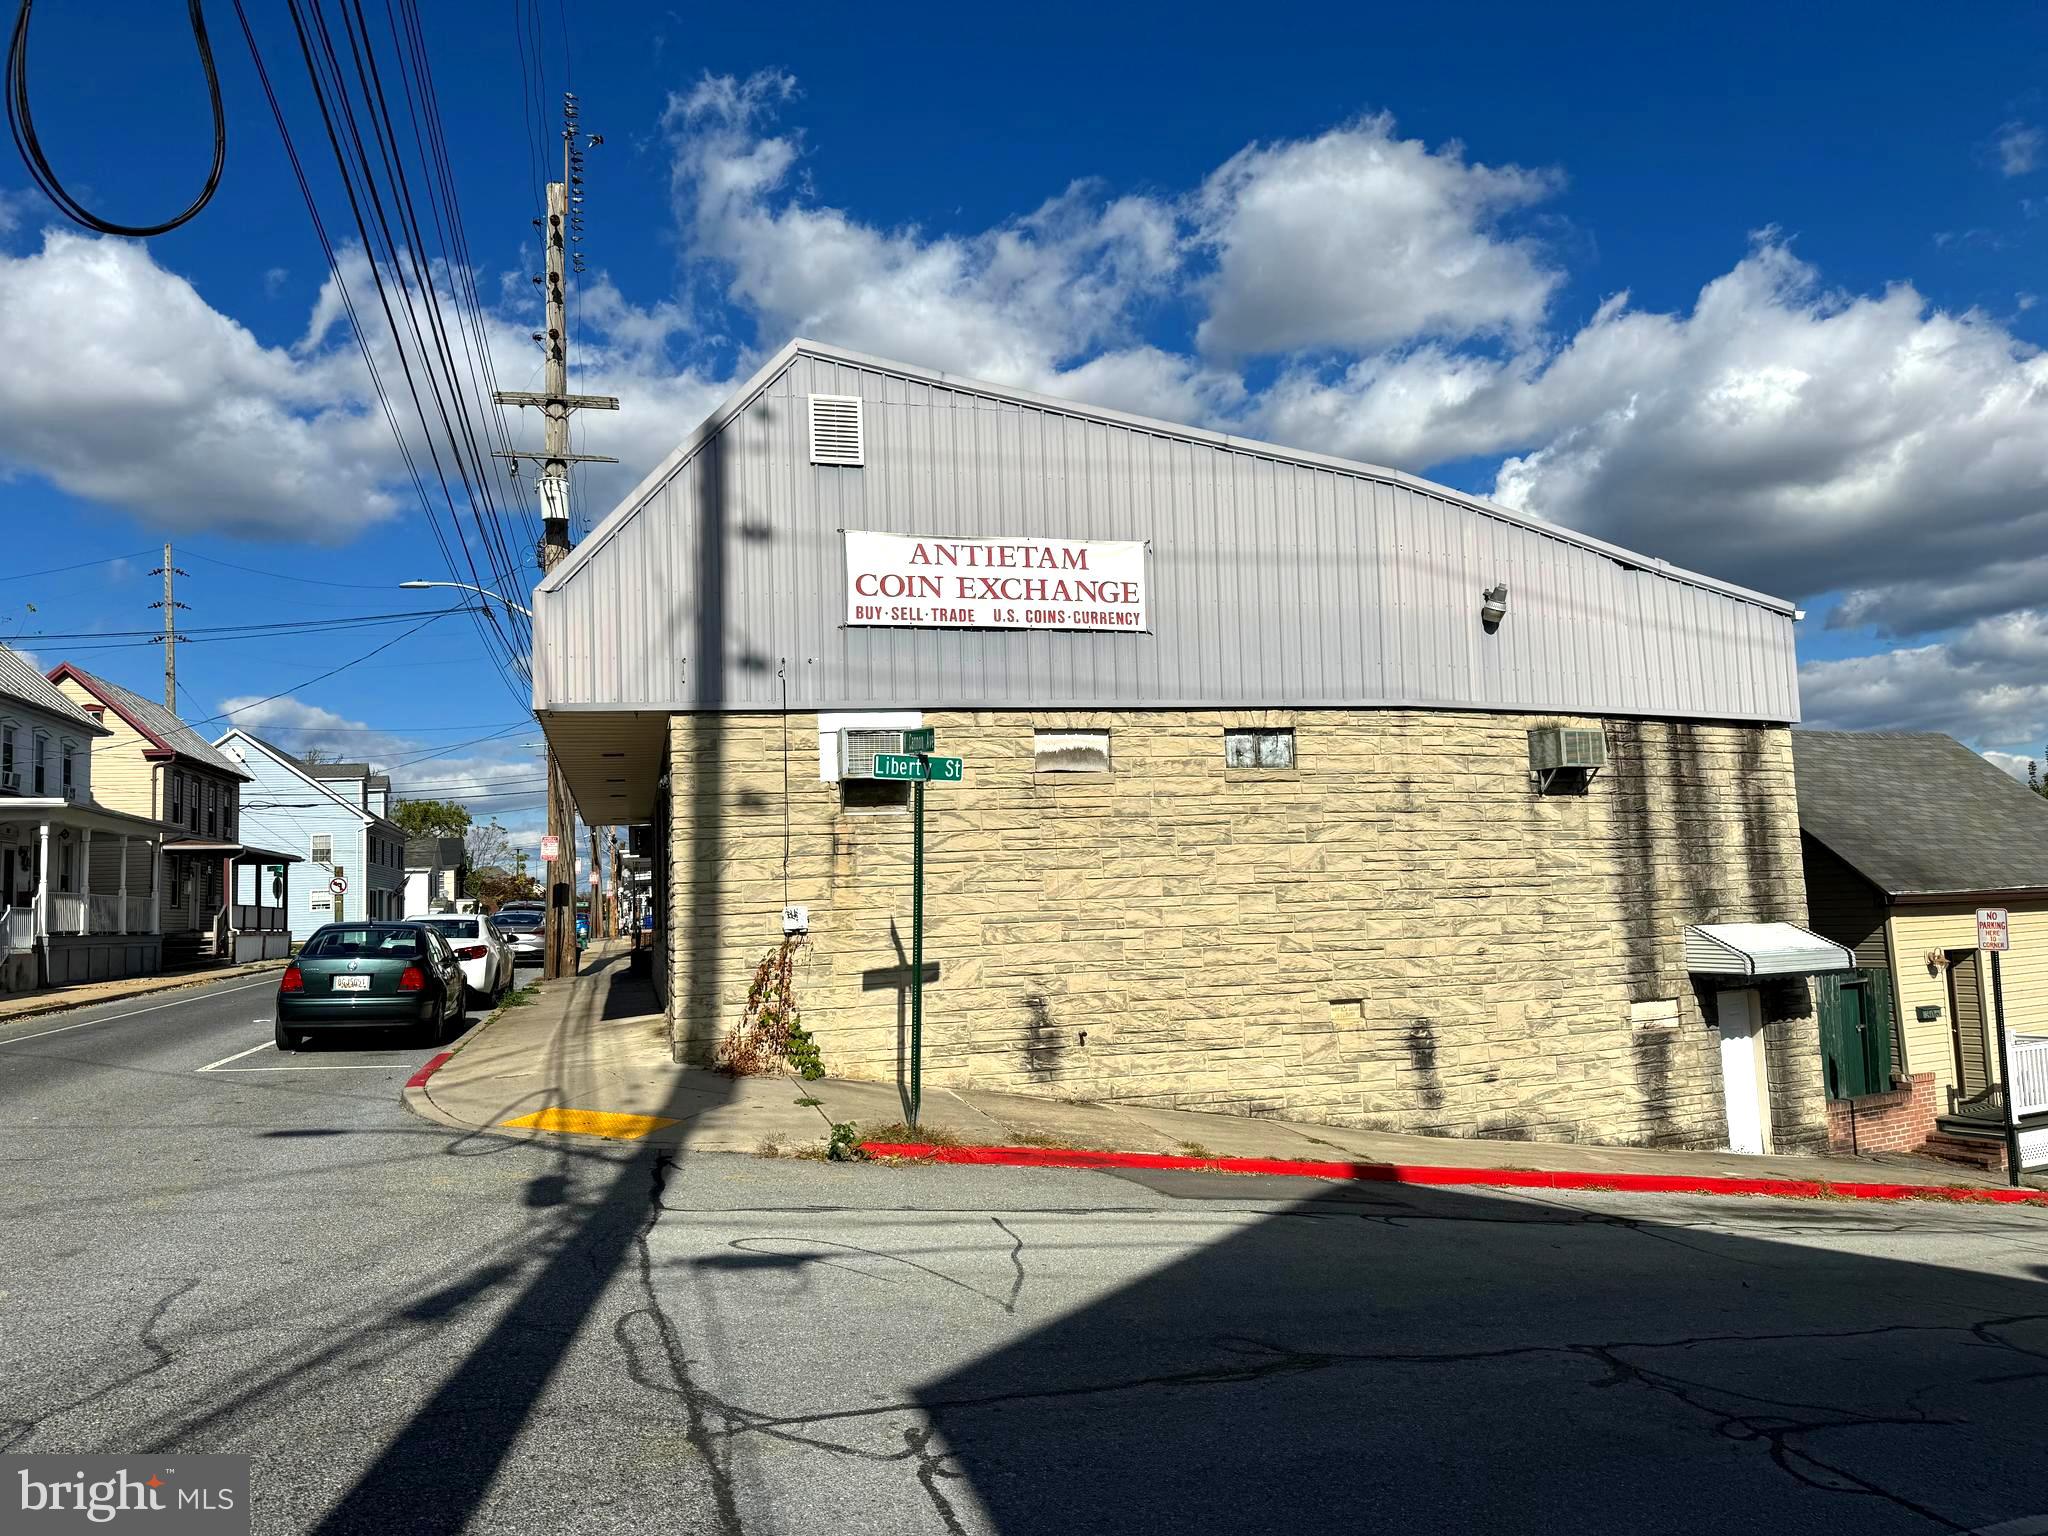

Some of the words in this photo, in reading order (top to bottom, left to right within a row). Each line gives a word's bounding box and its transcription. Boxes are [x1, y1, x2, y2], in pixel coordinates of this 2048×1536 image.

[908, 542, 1090, 571] ANTIETAM
[855, 573, 944, 599] COIN
[955, 576, 1140, 604] EXCHANGE
[993, 608, 1020, 623] U.S.
[875, 755, 932, 779] Liberty
[945, 759, 961, 778] St
[1986, 911, 1998, 920] NO
[1979, 922, 2006, 930] PARKING
